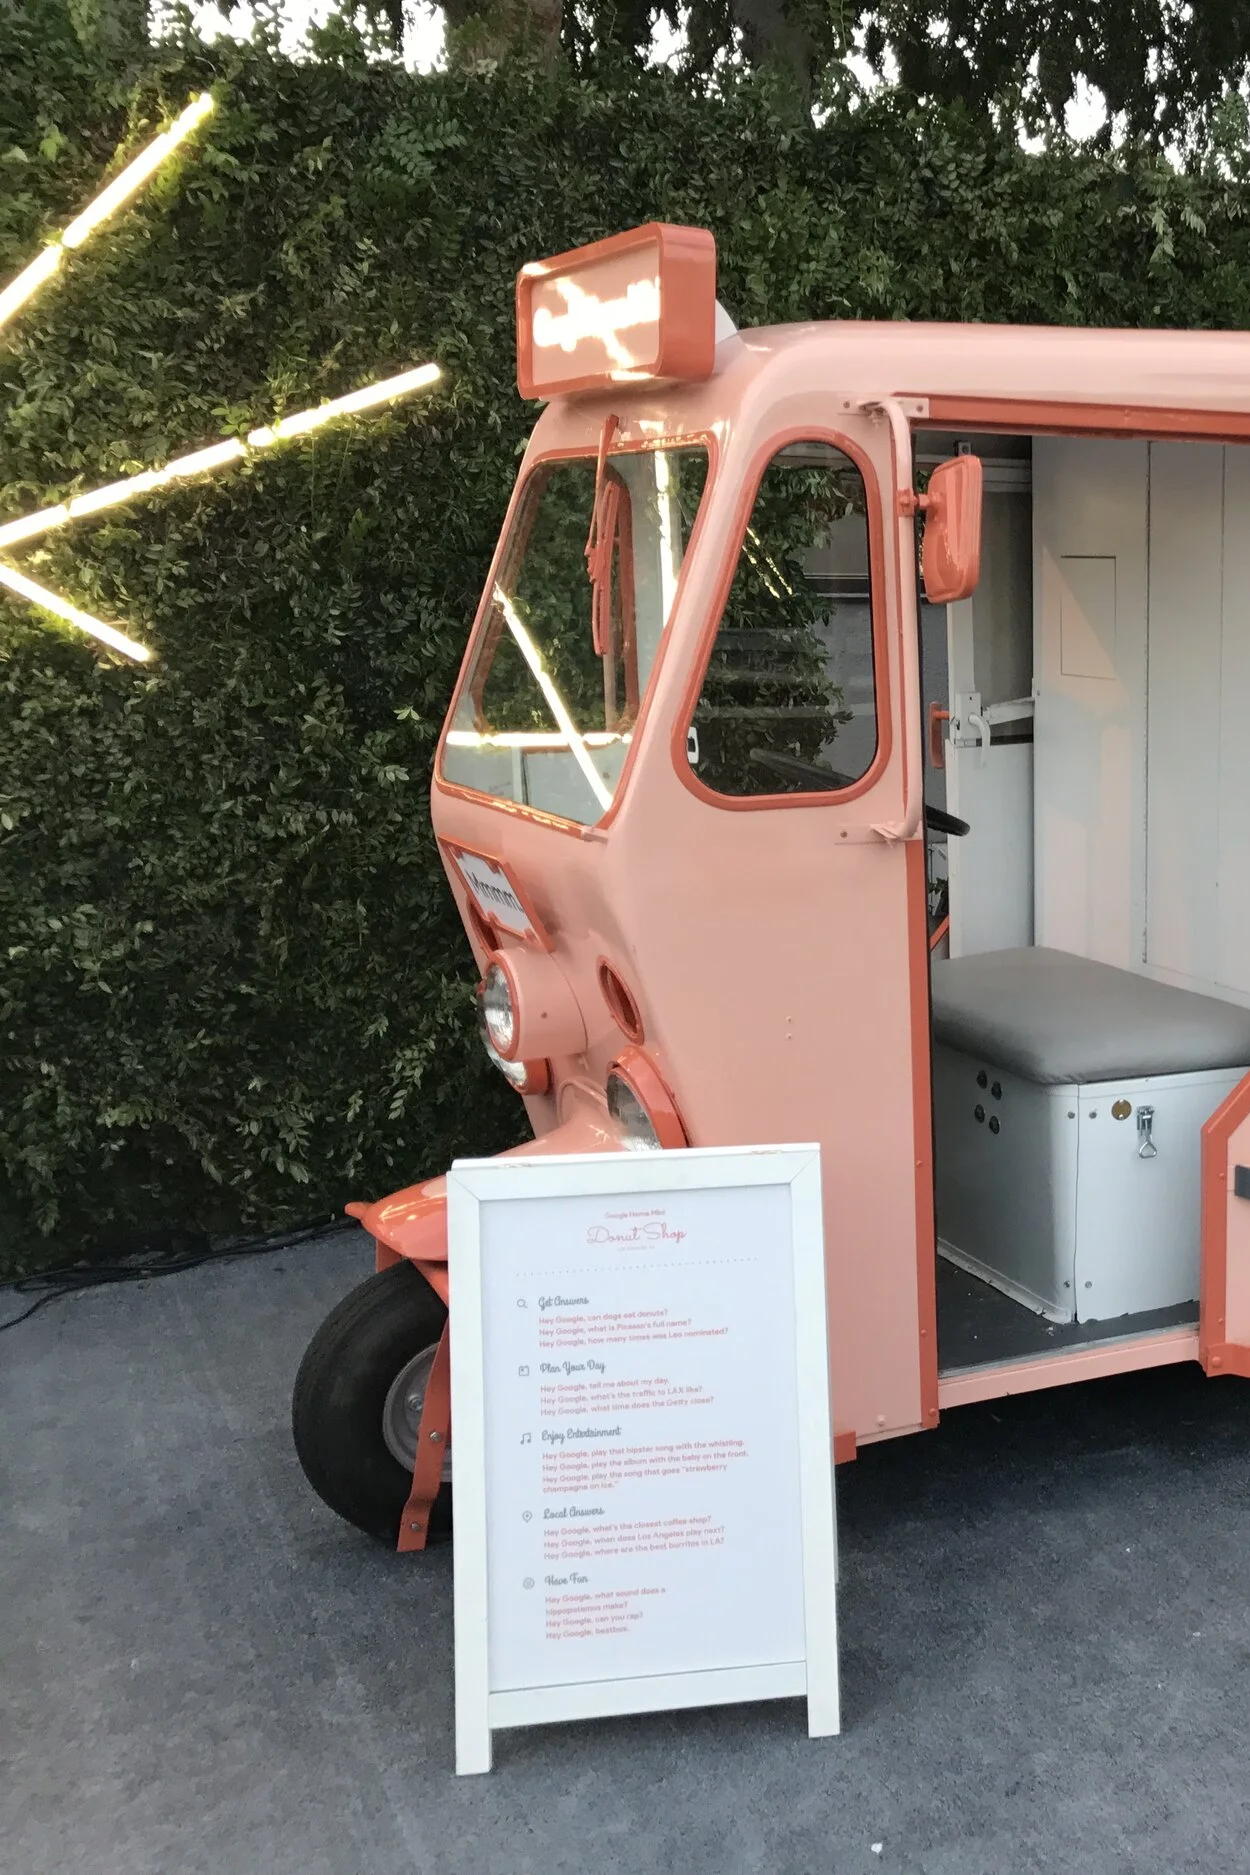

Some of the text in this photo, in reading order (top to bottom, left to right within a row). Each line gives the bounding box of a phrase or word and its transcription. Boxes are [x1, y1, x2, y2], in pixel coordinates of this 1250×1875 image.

[586, 1222, 687, 1243] Donut Shop
[539, 1296, 589, 1311] Get Answers
[539, 1317, 553, 1325] Hey
[603, 1312, 621, 1321] dogs
[637, 1309, 667, 1317] donuts?
[539, 1328, 553, 1337] Hey
[588, 1324, 606, 1332] what
[617, 1322, 651, 1330] Picasso's
[653, 1320, 665, 1328] full
[667, 1319, 691, 1327] name?
[540, 1340, 554, 1348] Hey
[588, 1336, 605, 1344] how
[629, 1333, 650, 1341] times
[685, 1327, 728, 1337] nominated?
[540, 1360, 605, 1375] Plan Your Day
[541, 1385, 555, 1393] Hey
[589, 1381, 600, 1389] tell
[617, 1379, 639, 1387] about
[541, 1397, 555, 1405] Hey
[618, 1391, 630, 1399] the
[633, 1389, 655, 1398] traffic
[668, 1387, 683, 1395] LAX
[686, 1386, 702, 1394] like?
[541, 1408, 556, 1417] Hey
[591, 1404, 610, 1412] what
[613, 1403, 629, 1411] time
[652, 1400, 664, 1408] the
[667, 1398, 688, 1407] Getty
[690, 1396, 713, 1405] close?
[542, 1426, 621, 1444] Enjoy Entertainment
[543, 1452, 557, 1461] Hey
[591, 1448, 606, 1458] play
[609, 1447, 624, 1455] that
[627, 1445, 653, 1455] hipster
[676, 1442, 692, 1450] with
[694, 1441, 706, 1449] the
[543, 1464, 557, 1472] Hey
[592, 1460, 607, 1469] play
[624, 1457, 647, 1465] album
[649, 1455, 665, 1463] with
[682, 1453, 701, 1462] baby
[714, 1451, 726, 1459] the
[543, 1475, 558, 1484] Hey
[592, 1472, 607, 1481] play
[610, 1470, 622, 1478] the
[644, 1467, 660, 1475] that
[662, 1468, 680, 1476] goes
[543, 1485, 587, 1493] champagne
[543, 1507, 605, 1519] Local Answers
[544, 1529, 558, 1537] Hey
[635, 1520, 661, 1529] closest
[663, 1518, 687, 1527] coffee
[689, 1516, 711, 1525] shop?
[544, 1541, 559, 1549] Hey
[594, 1536, 614, 1544] when
[653, 1530, 684, 1540] Angeles
[686, 1529, 701, 1538] play
[704, 1526, 725, 1535] next?
[544, 1552, 559, 1561] Hey
[635, 1544, 648, 1552] the
[650, 1542, 667, 1551] best
[669, 1540, 699, 1549] burritos
[710, 1538, 724, 1546] LA?
[545, 1572, 588, 1586] Have Fun
[546, 1596, 560, 1604] Hey
[595, 1591, 613, 1599] what
[616, 1588, 639, 1597] sound
[603, 1602, 627, 1611] make?
[546, 1620, 560, 1628] Hey
[612, 1615, 624, 1623] you
[546, 1632, 561, 1640] Hey
